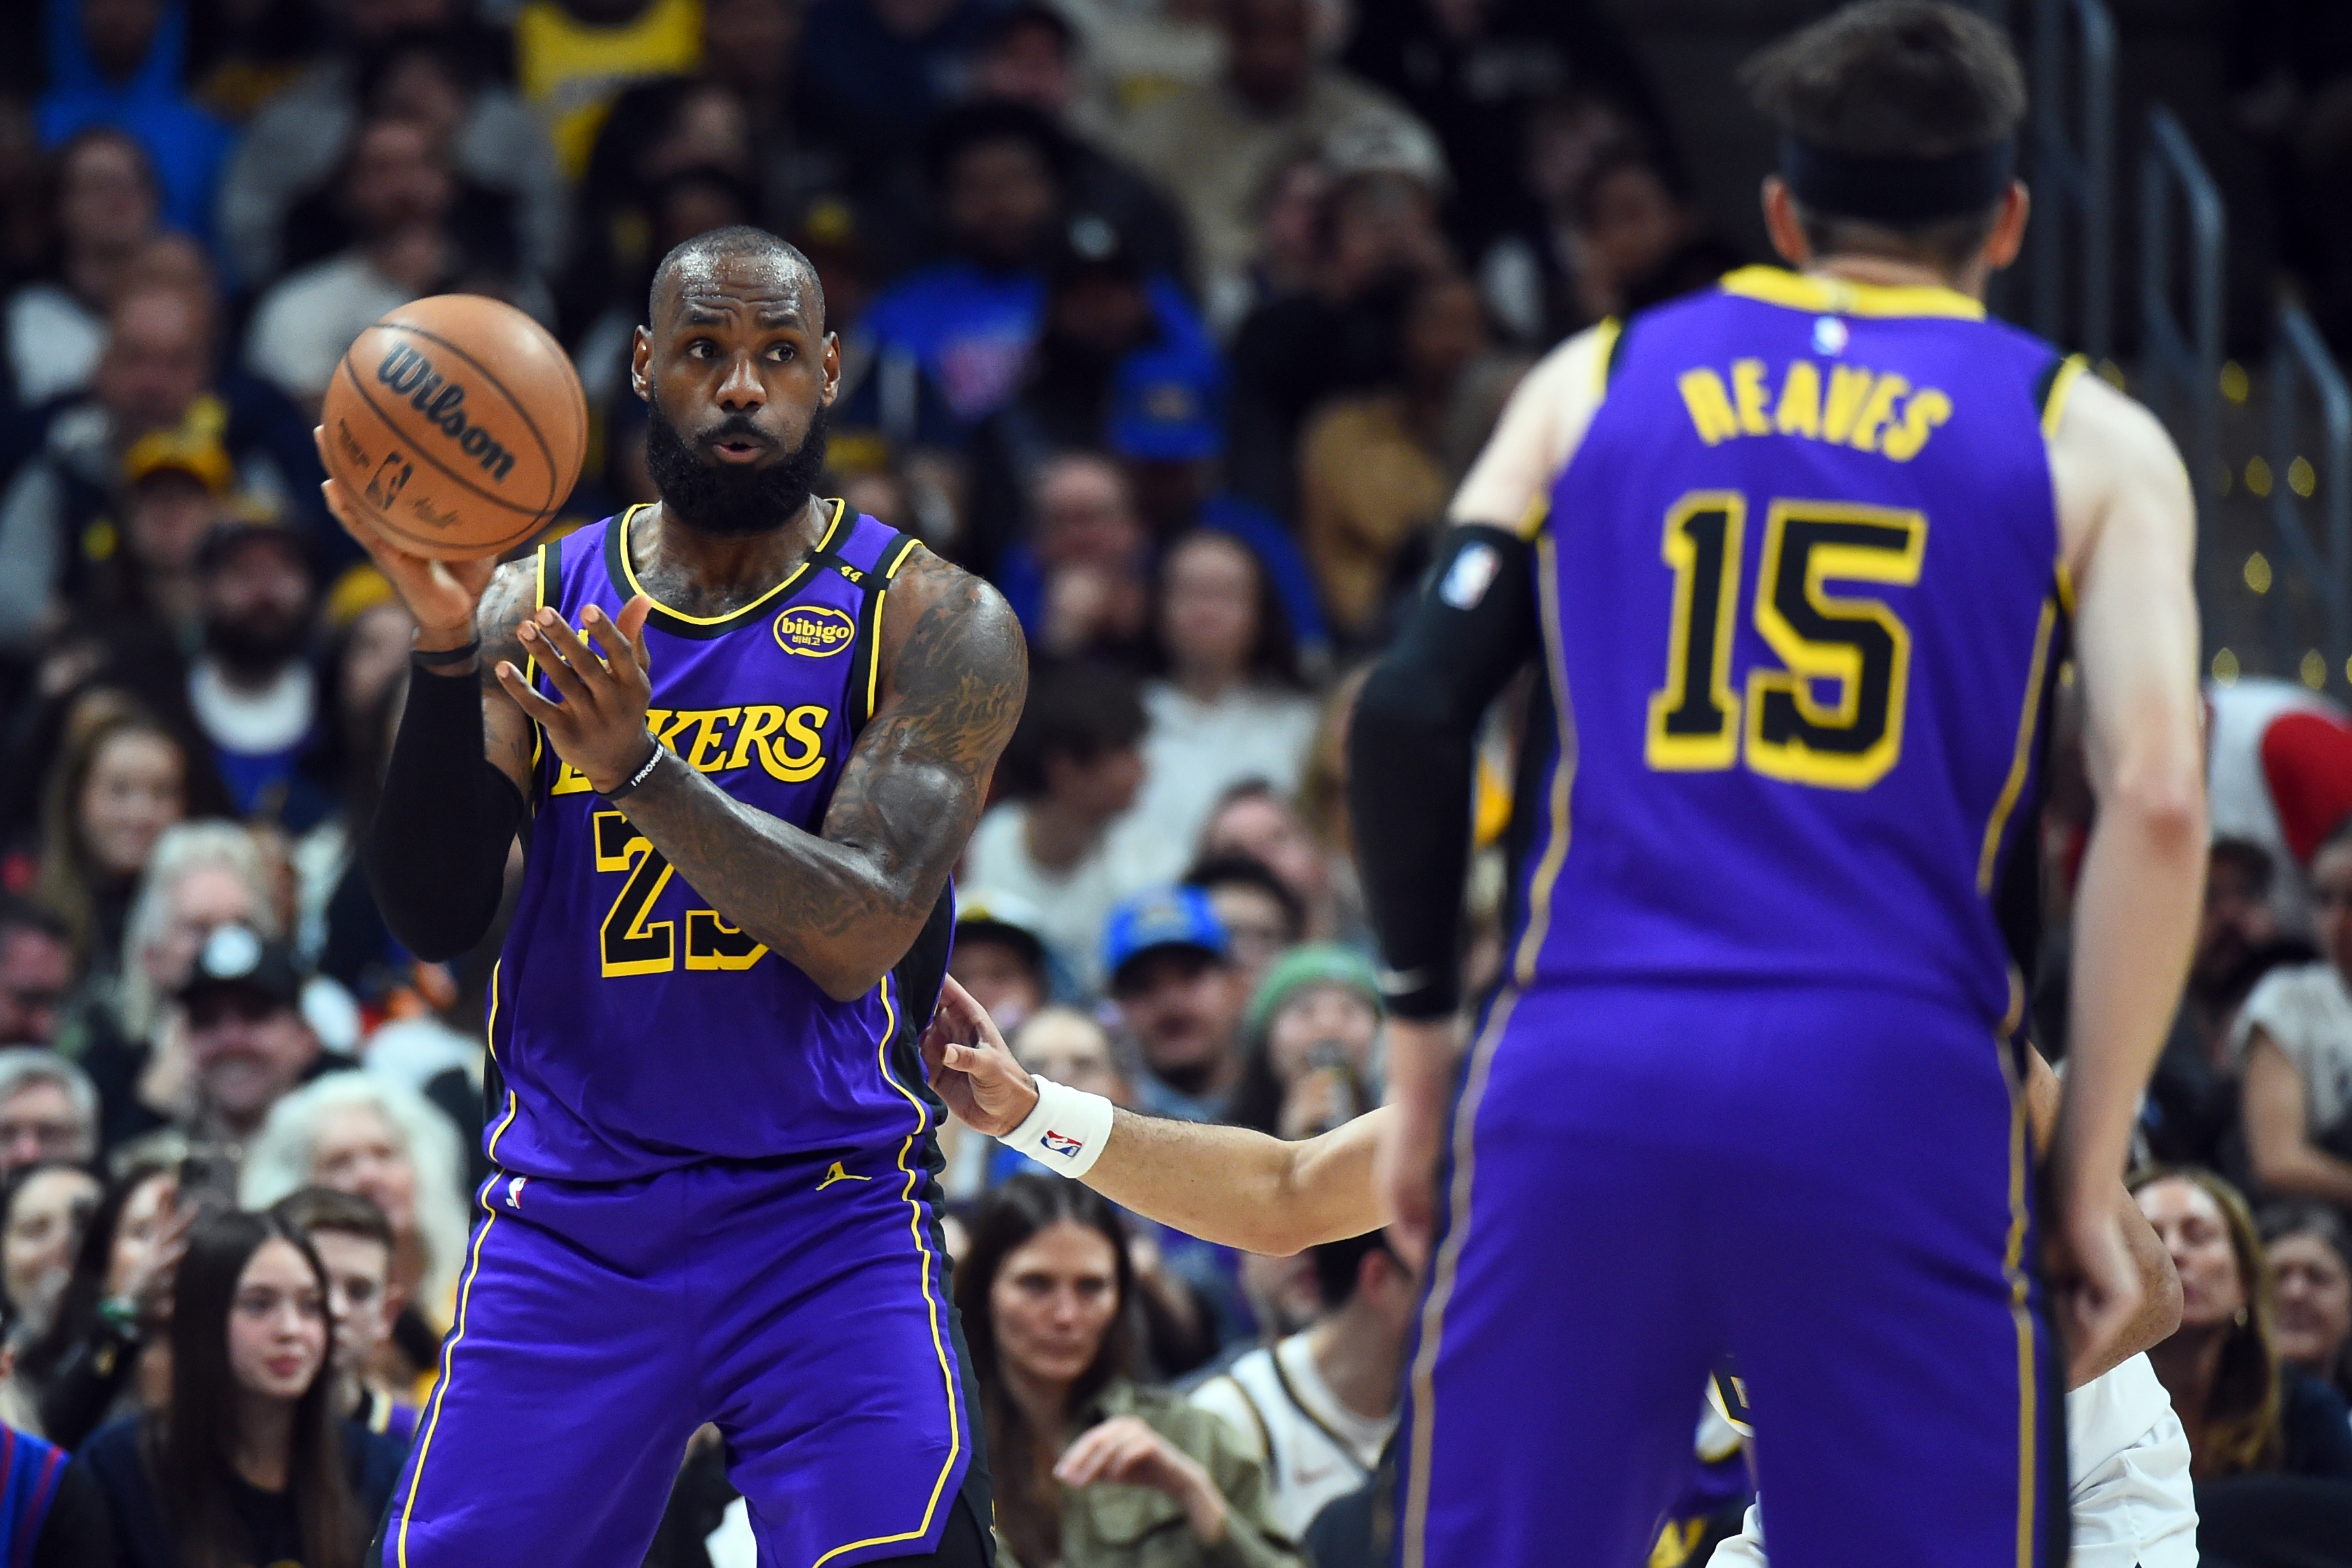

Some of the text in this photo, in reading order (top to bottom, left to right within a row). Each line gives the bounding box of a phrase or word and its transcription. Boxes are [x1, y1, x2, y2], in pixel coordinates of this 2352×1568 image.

[379, 341, 515, 483] Wilson
[1679, 358, 1951, 462] REAVES
[841, 565, 863, 582] 44
[782, 617, 850, 644] bibigo
[792, 635, 820, 646] 비비고
[1646, 490, 1927, 791] 15
